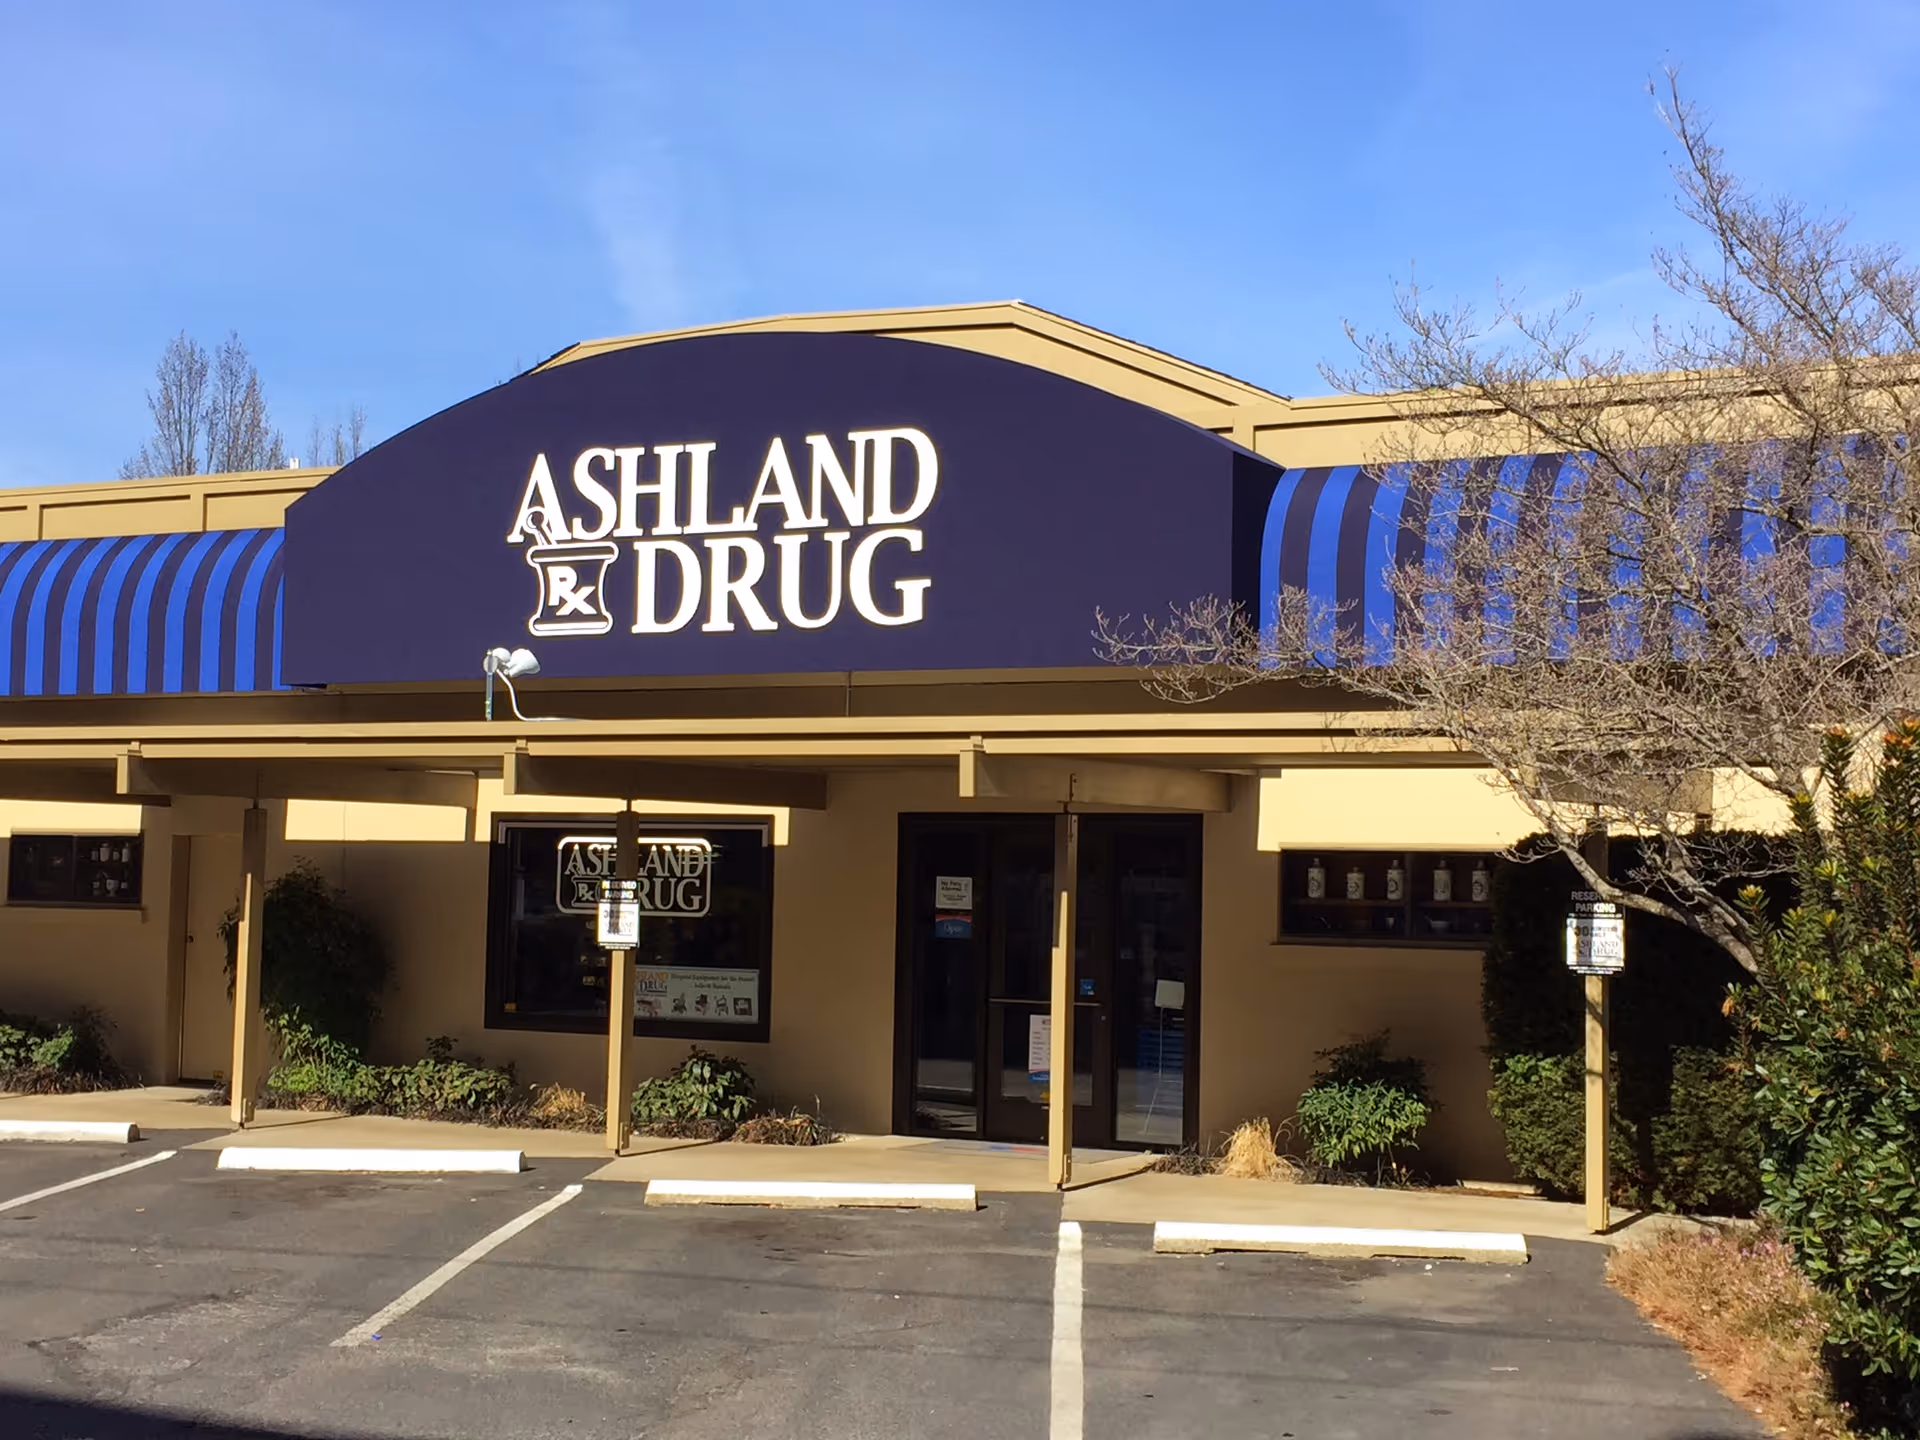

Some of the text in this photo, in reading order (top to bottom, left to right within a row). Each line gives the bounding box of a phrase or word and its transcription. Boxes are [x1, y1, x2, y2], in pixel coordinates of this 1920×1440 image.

[507, 428, 938, 543] ASHLAND
[631, 529, 932, 634] DRUG
[634, 877, 702, 911] RUG
[1571, 891, 1601, 901] RESER
[1575, 902, 1616, 913] PARKING
